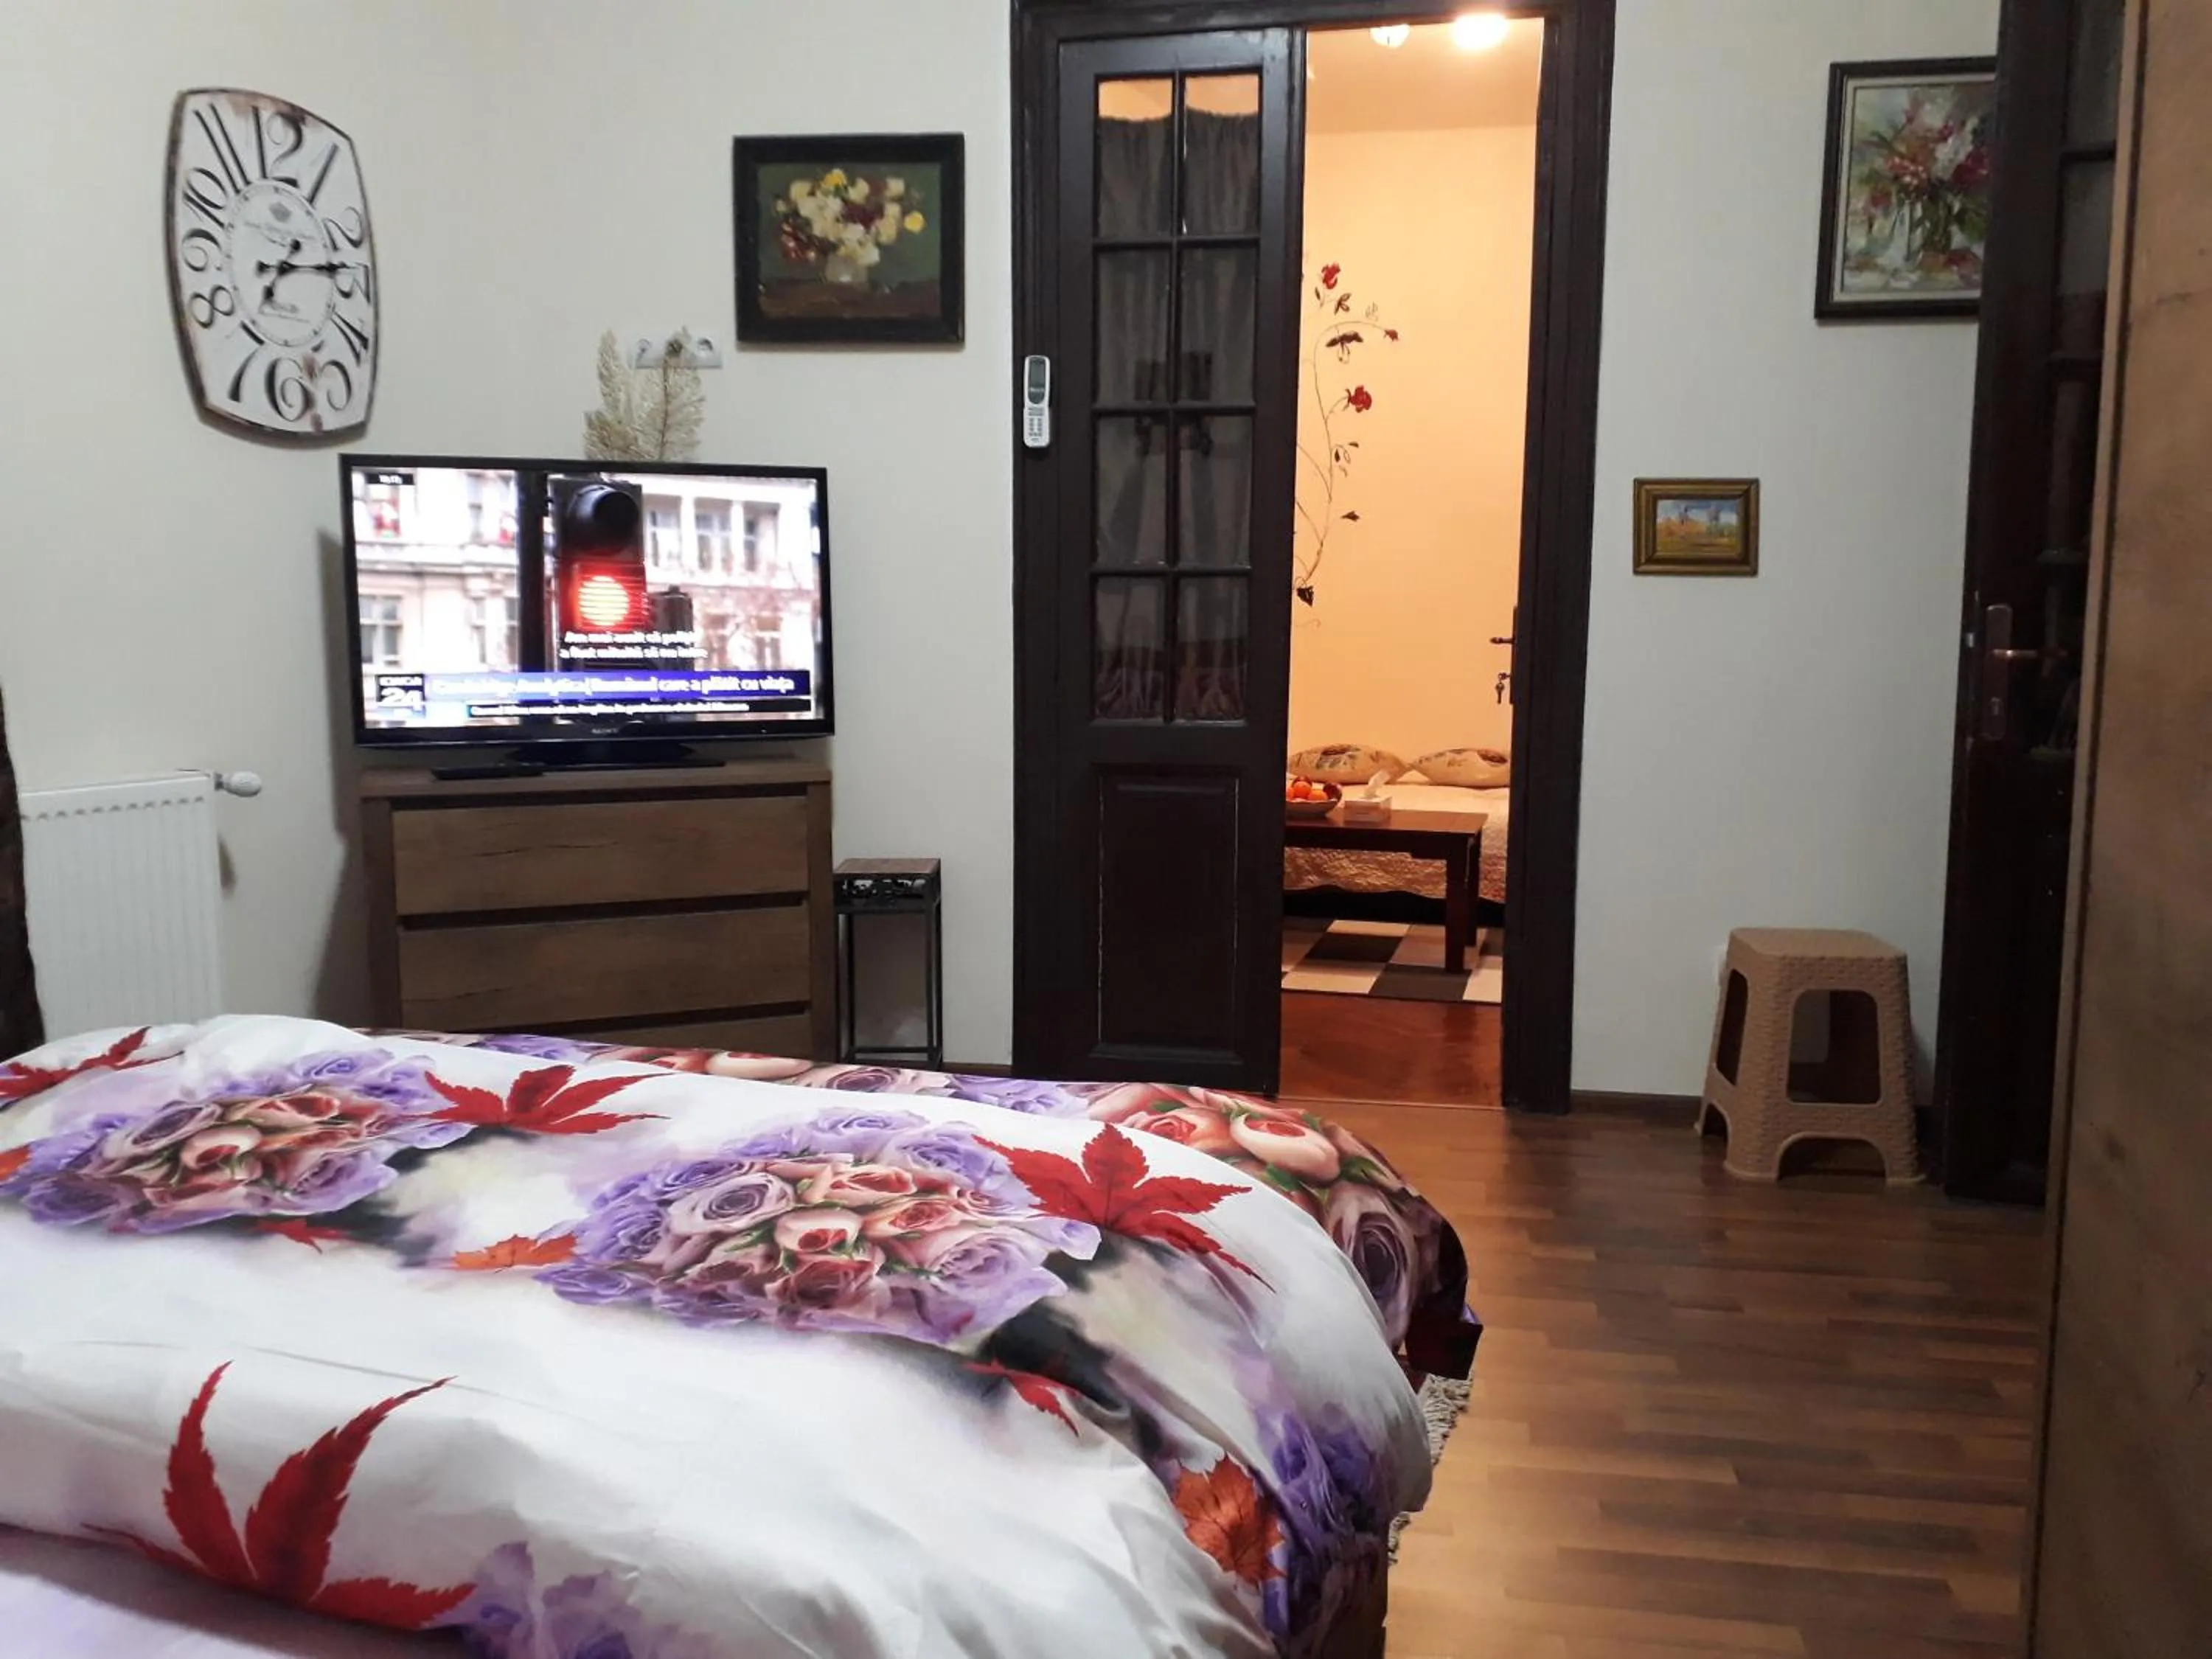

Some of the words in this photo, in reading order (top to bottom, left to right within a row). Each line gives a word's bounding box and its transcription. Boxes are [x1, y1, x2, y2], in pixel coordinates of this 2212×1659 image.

[181, 227, 221, 272] 9
[322, 206, 364, 251] 2
[187, 284, 234, 330] 8
[264, 357, 315, 422] 6
[380, 687, 423, 711] 24
